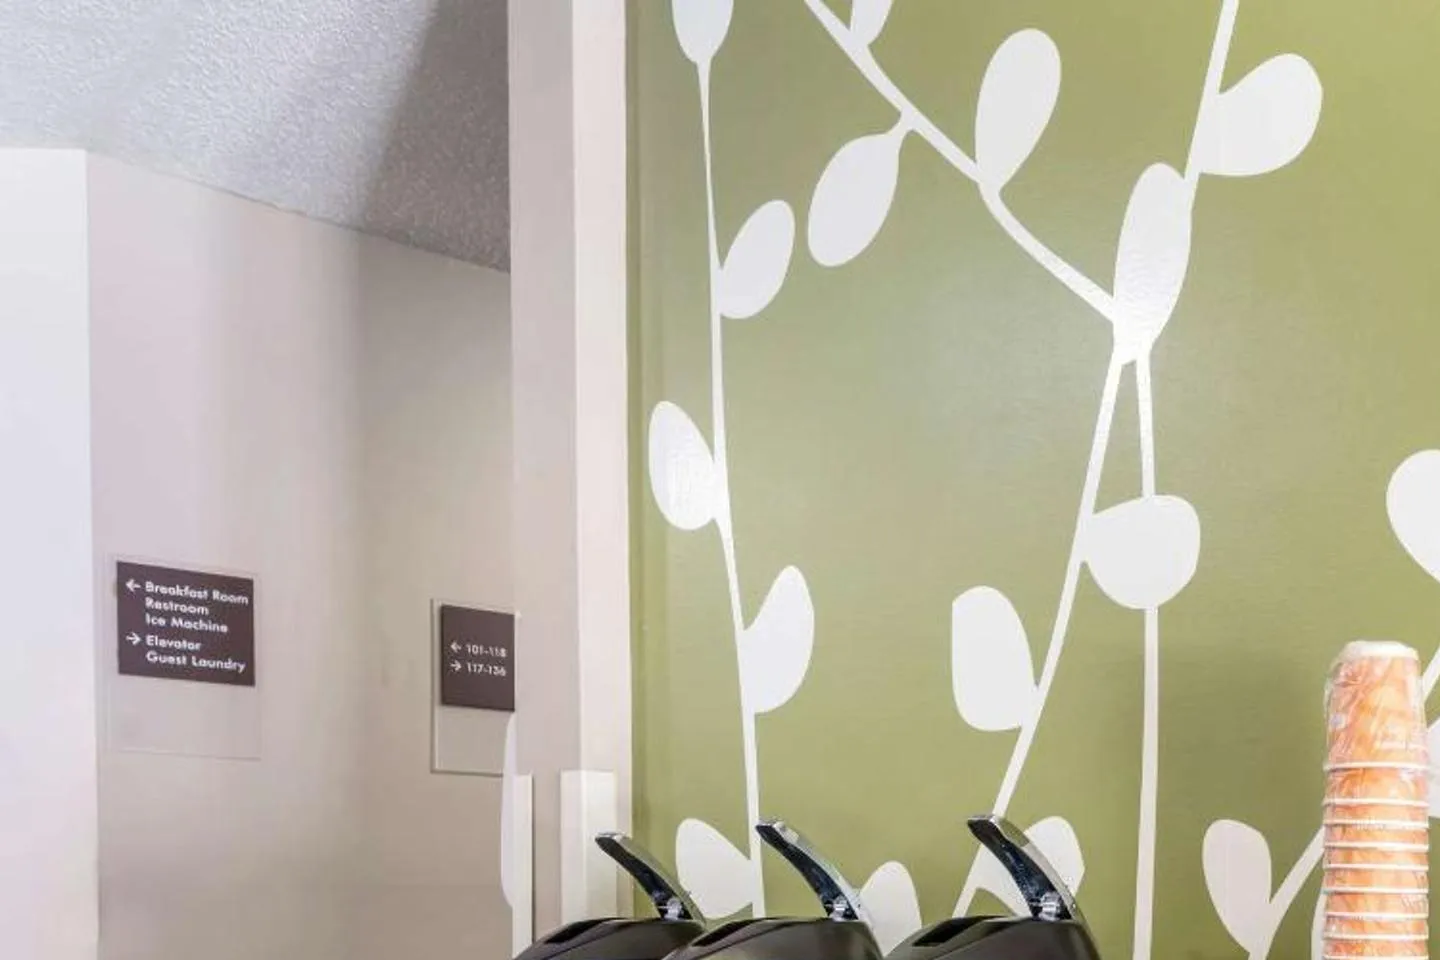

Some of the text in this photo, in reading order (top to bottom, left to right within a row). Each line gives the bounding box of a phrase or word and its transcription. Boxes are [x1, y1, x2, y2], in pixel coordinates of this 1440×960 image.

[145, 581, 249, 605] Breakfast Room
[145, 597, 210, 615] Restroom
[145, 612, 229, 633] Ice Machine
[145, 635, 201, 651] Elevator
[146, 650, 246, 674] Guest Laundry
